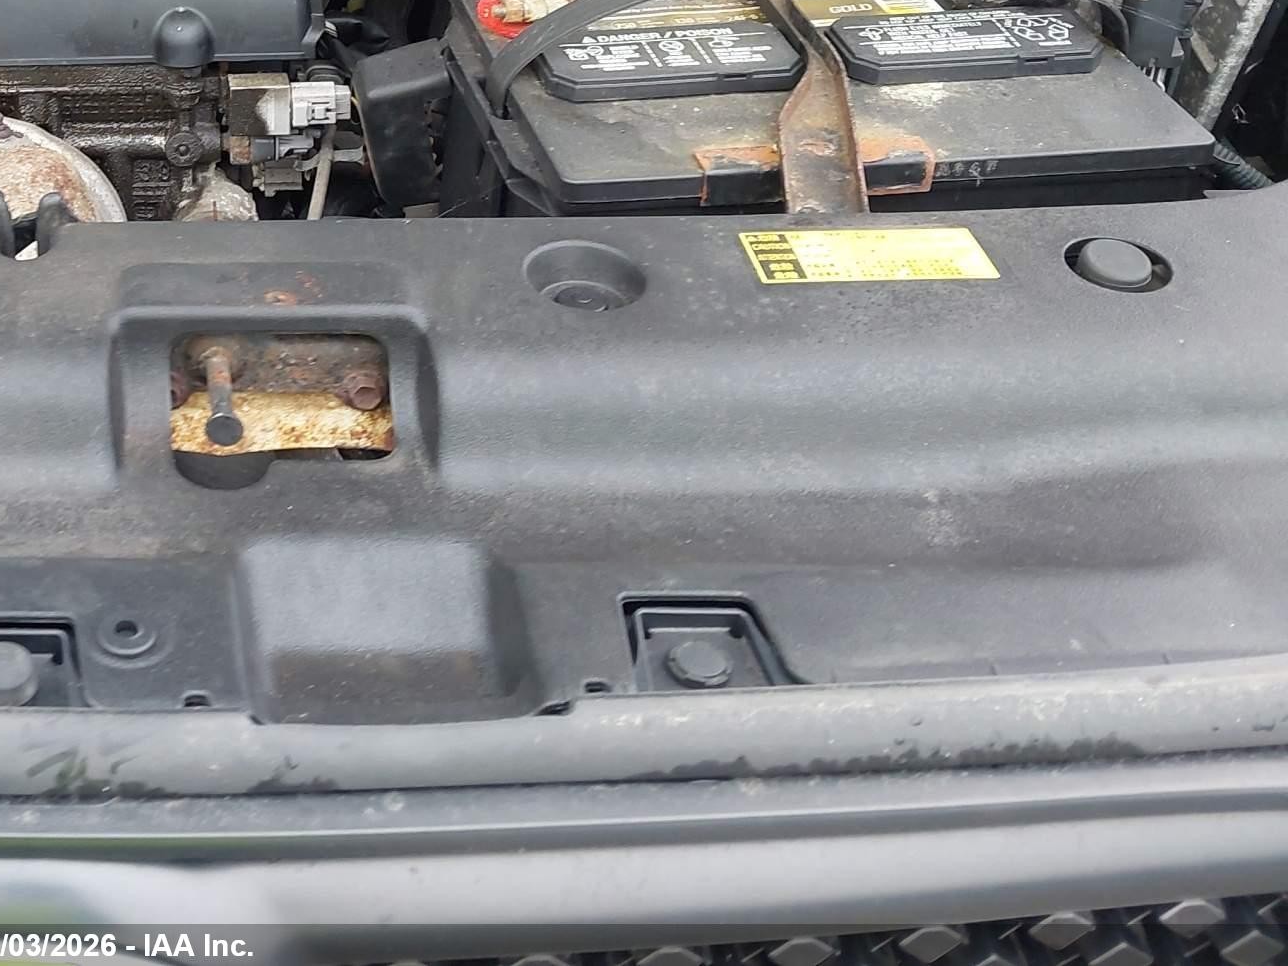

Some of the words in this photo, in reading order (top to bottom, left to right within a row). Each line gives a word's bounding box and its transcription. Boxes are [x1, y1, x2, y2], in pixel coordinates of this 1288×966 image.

[829, 3, 873, 14] GOLD
[598, 31, 661, 43] DANGER
[675, 28, 734, 38] POISON
